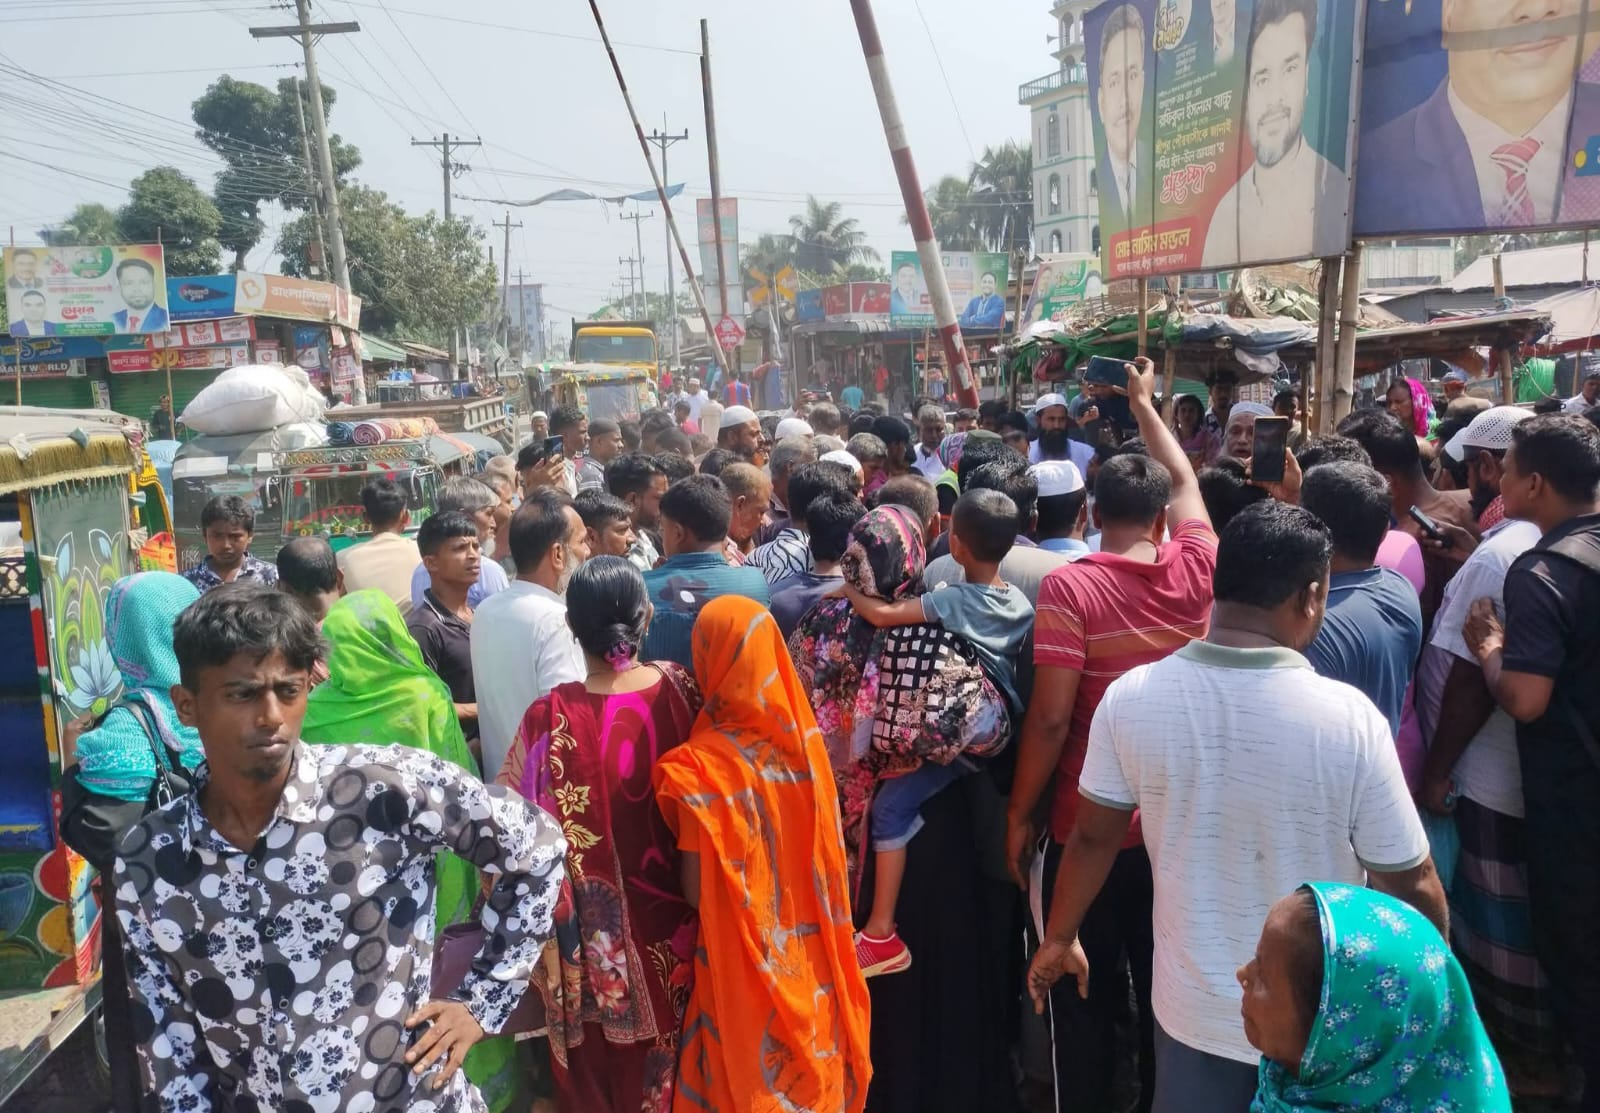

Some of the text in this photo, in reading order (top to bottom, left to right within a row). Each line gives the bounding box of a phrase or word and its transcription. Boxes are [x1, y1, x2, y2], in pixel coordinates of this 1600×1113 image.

[1158, 108, 1185, 128] রফিকুল
[1186, 97, 1212, 119] ইসলাম
[1160, 161, 1216, 204] শুভেচ্ছা
[1131, 229, 1159, 257] নাসিম
